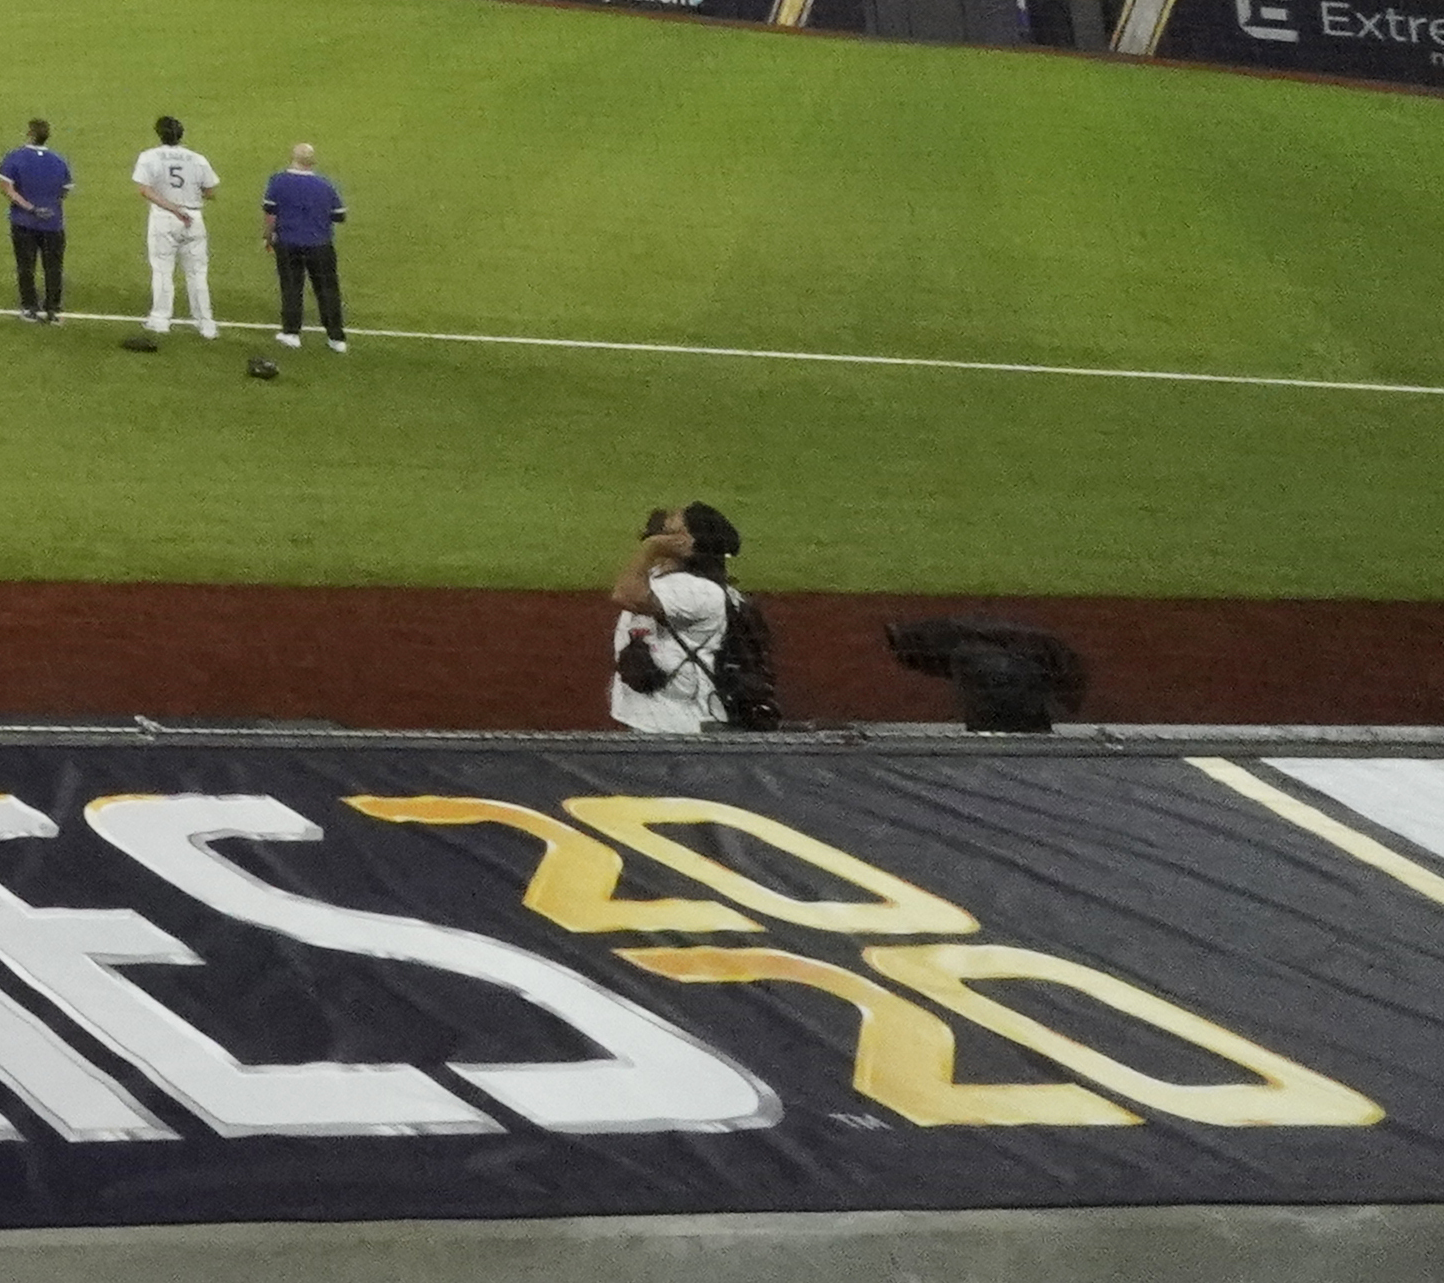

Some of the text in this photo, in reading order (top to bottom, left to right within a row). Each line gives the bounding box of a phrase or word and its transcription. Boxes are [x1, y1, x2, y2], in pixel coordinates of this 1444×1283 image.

[168, 165, 185, 189] 5
[344, 794, 982, 936] 20
[614, 941, 1388, 1129] 20
